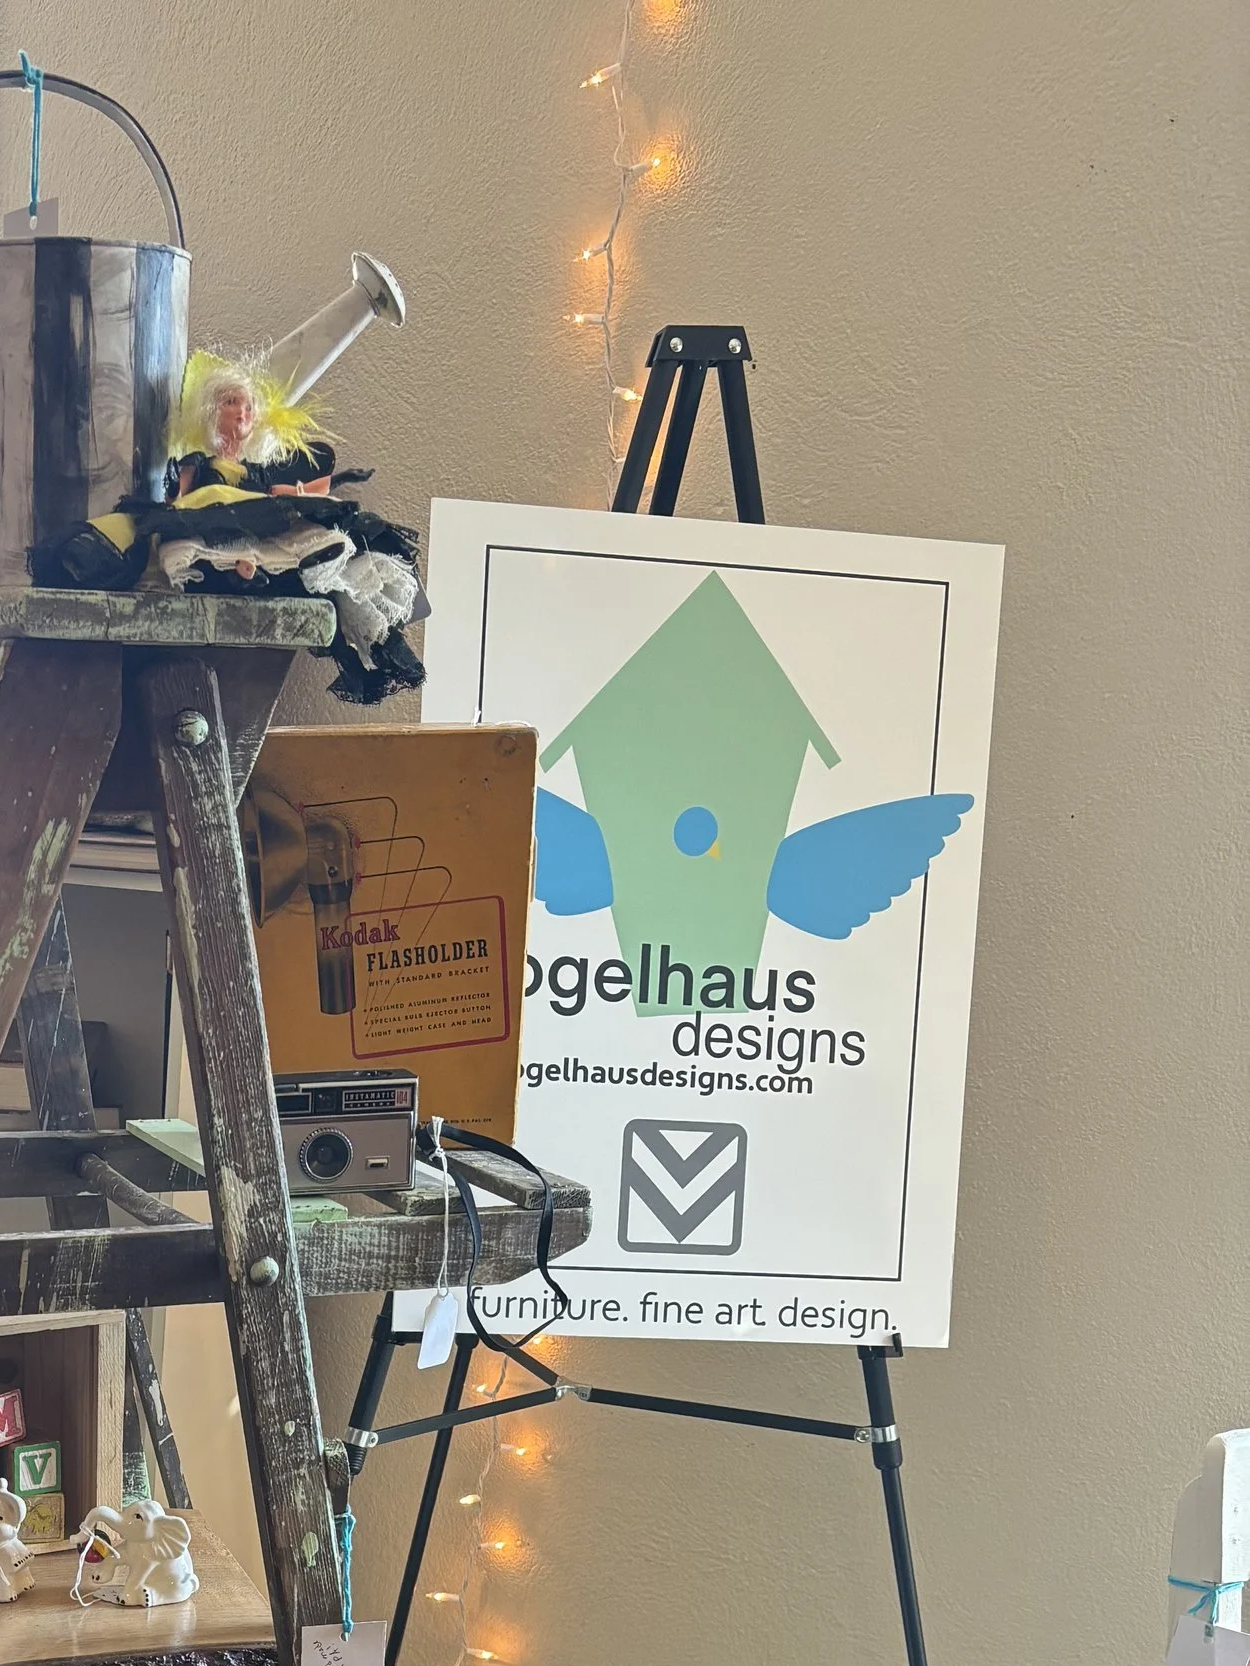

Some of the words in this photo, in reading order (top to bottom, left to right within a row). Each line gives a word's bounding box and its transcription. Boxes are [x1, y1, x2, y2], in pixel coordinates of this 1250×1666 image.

[320, 918, 401, 950] Kodak
[366, 938, 489, 972] FLASHOLDER
[368, 979, 390, 987] WITH
[396, 972, 443, 985] STANDARD
[448, 966, 490, 978] BRACKET
[369, 1002, 405, 1013] POLISHED
[408, 997, 448, 1008] ALUMINUM
[451, 992, 490, 1003] REFLECTOR
[370, 1015, 402, 1025] SPECIAL
[405, 1012, 423, 1021] BULB
[426, 1008, 458, 1018] EJECTOR
[461, 1004, 492, 1014] BUTTON
[371, 1029, 392, 1038] LIGHT
[396, 1025, 423, 1035] WEIGHT
[427, 1022, 446, 1031] CASE
[451, 1019, 467, 1028] AND
[471, 1016, 492, 1025] HEAD
[672, 1010, 866, 1076] designs
[520, 1057, 814, 1096] gelhausdesigns.com
[345, 1091, 395, 1101] INSTAMATIC
[469, 1286, 629, 1323] furniture.
[639, 1291, 704, 1325] fine
[778, 1296, 898, 1338] design.
[22, 1452, 52, 1486] V
